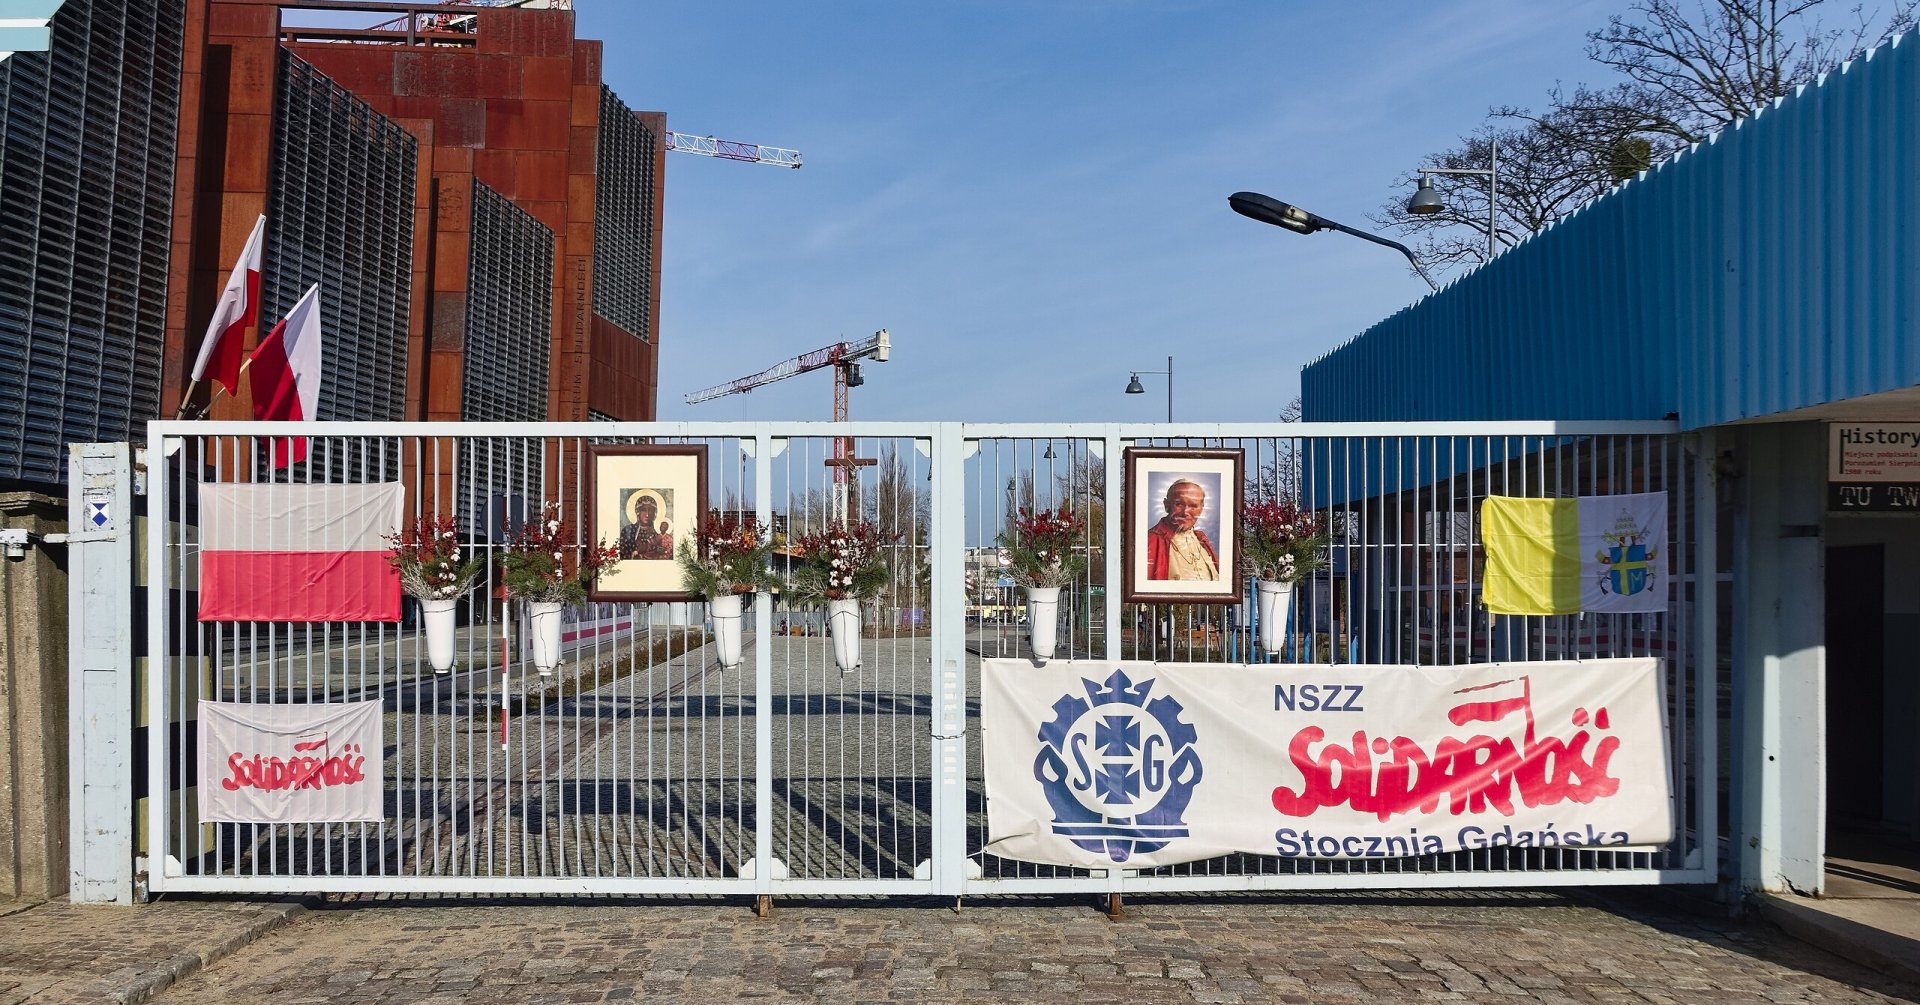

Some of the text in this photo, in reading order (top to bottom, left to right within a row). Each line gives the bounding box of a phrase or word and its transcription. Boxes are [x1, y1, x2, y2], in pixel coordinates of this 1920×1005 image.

[1840, 427, 1920, 448] History
[1840, 486, 1873, 506] TU
[1274, 684, 1364, 712] NSZZ
[1071, 733, 1165, 792] S G
[1274, 823, 1630, 858] Stocznia Gdańska
